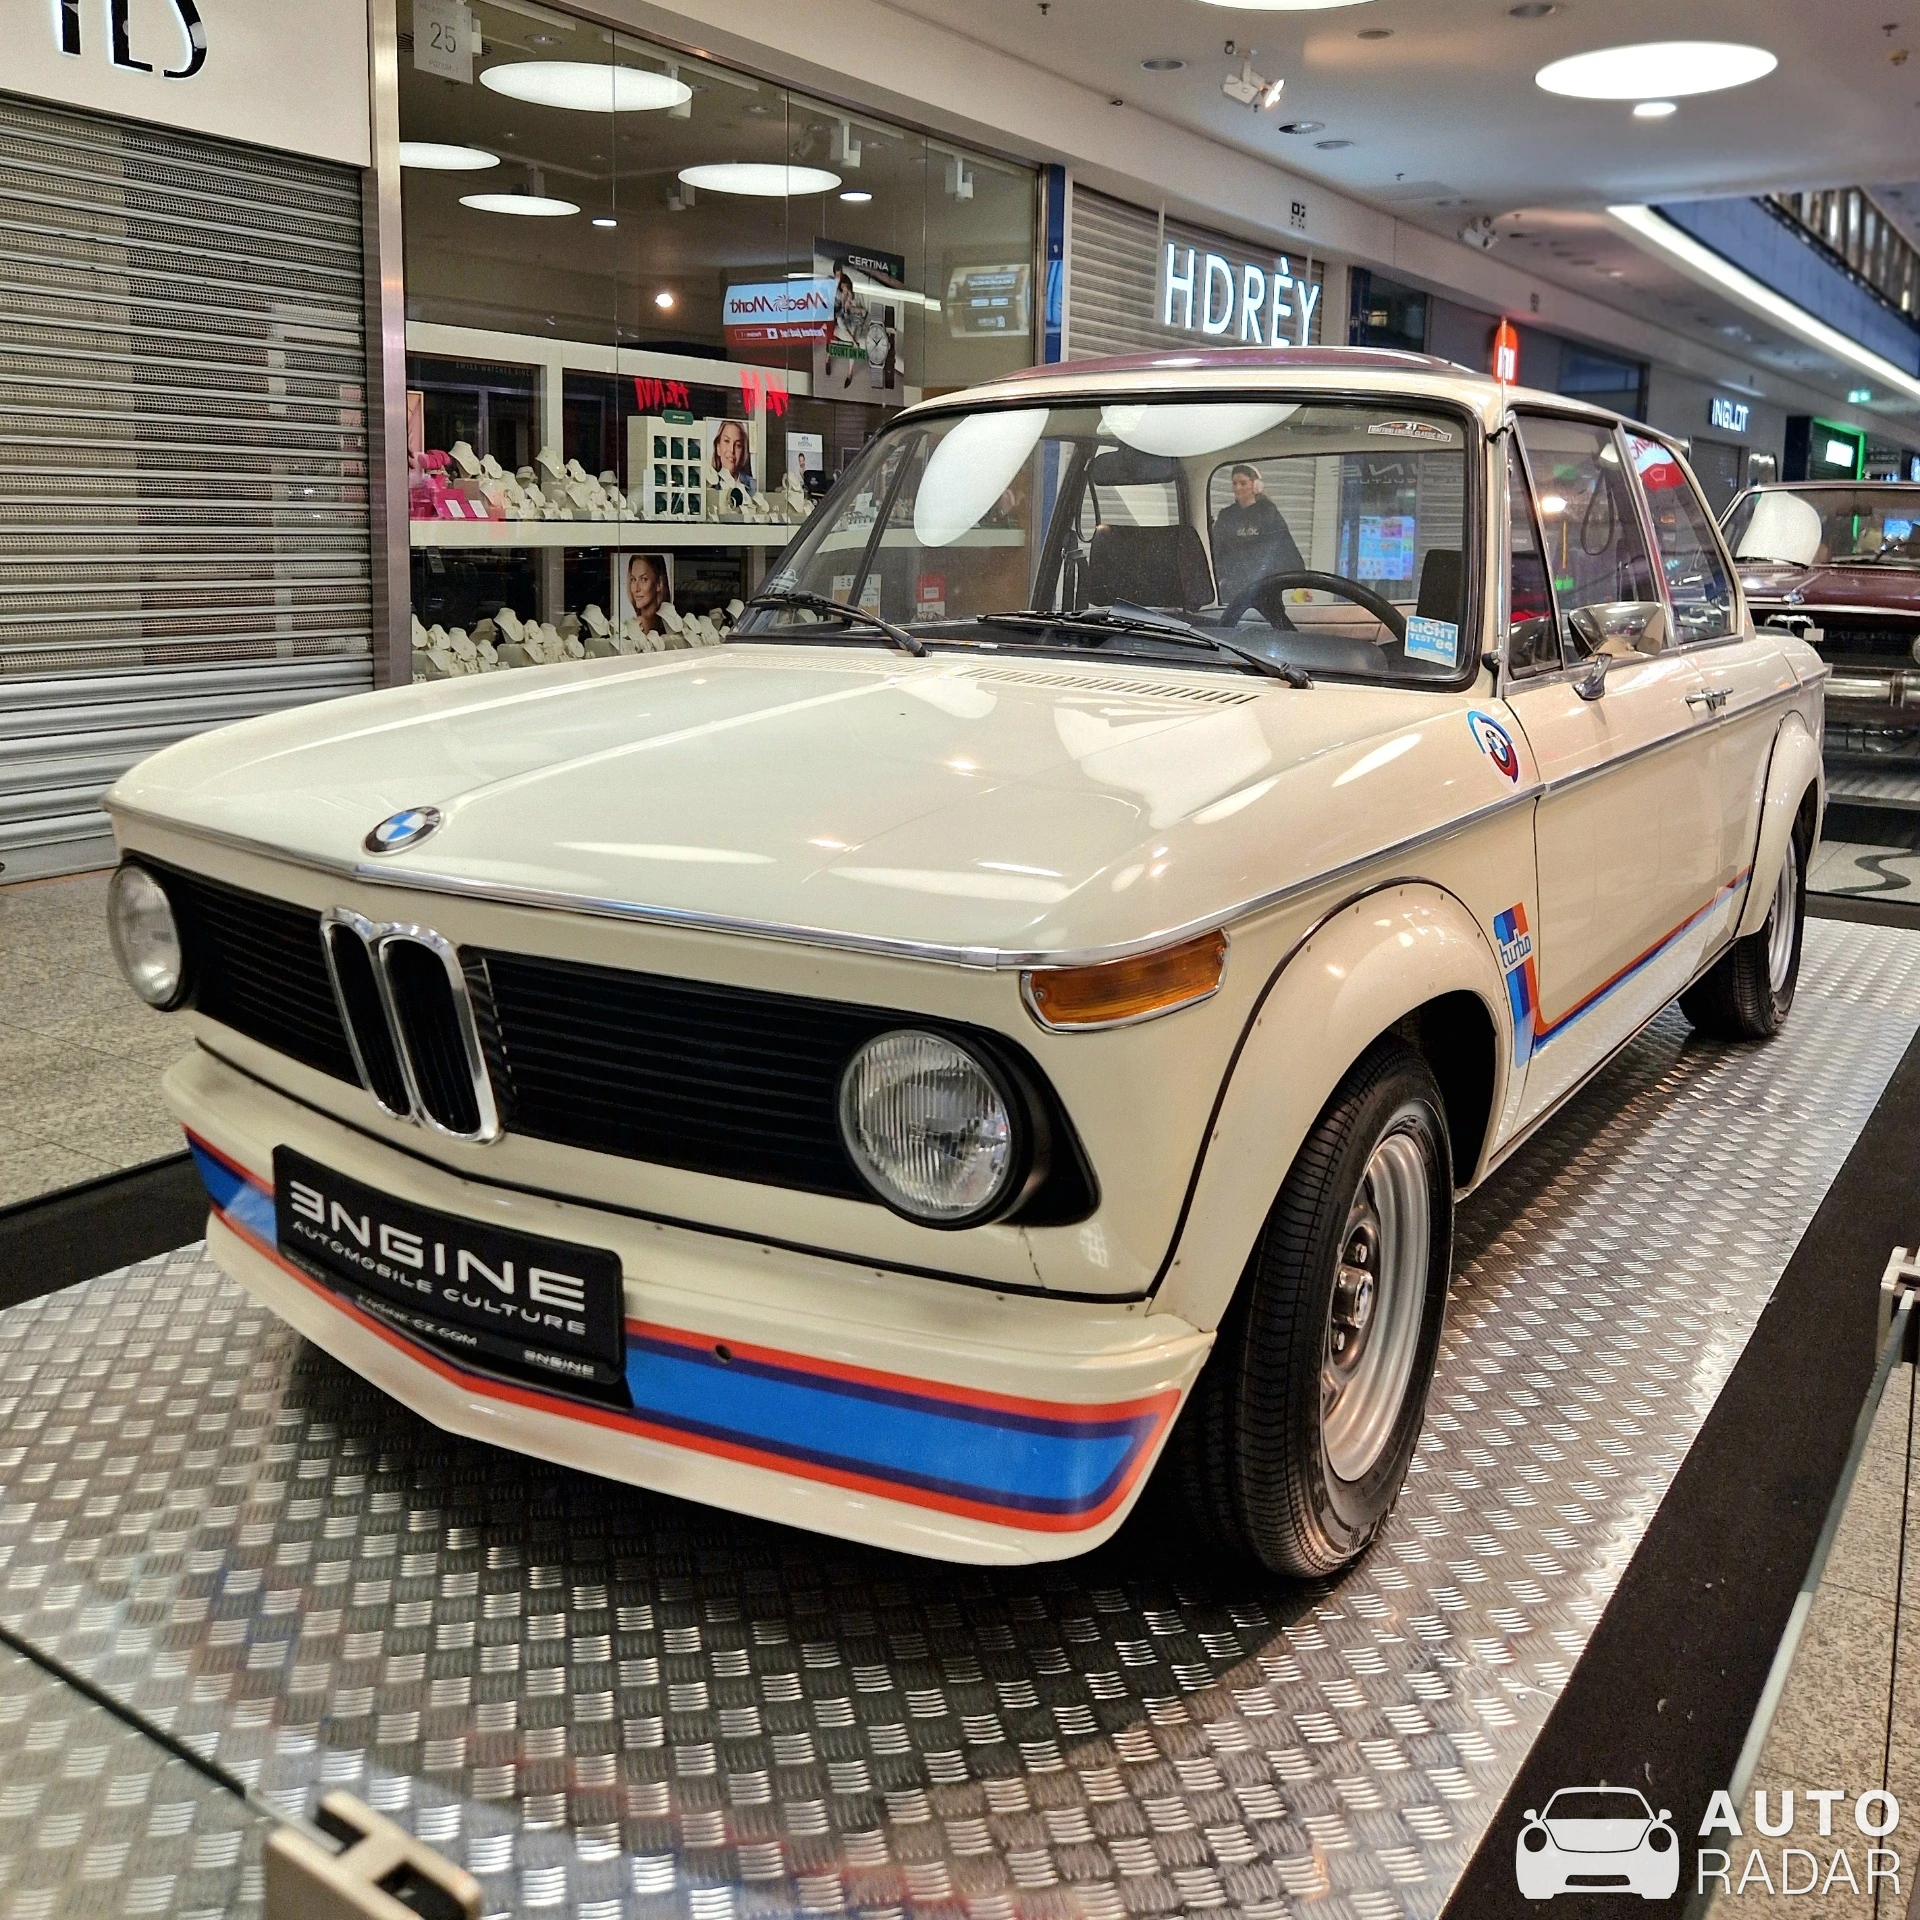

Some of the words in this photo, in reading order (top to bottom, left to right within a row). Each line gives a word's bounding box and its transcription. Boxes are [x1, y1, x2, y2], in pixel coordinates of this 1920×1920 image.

[430, 22, 456, 53] 25
[848, 255, 889, 272] CERTINA
[830, 345, 848, 357] COUNT
[849, 347, 857, 357] ON
[858, 349, 867, 359] ME
[481, 365, 512, 375] WATCHES
[1711, 398, 1749, 432] INGLOT
[1405, 423, 1417, 431] 21
[1414, 430, 1436, 438] CLASSIC
[1410, 622, 1454, 640] LICHT
[1499, 933, 1532, 968] turbo
[292, 1221, 434, 1294] AUTOMOBILE
[443, 1288, 586, 1335] CULTURE
